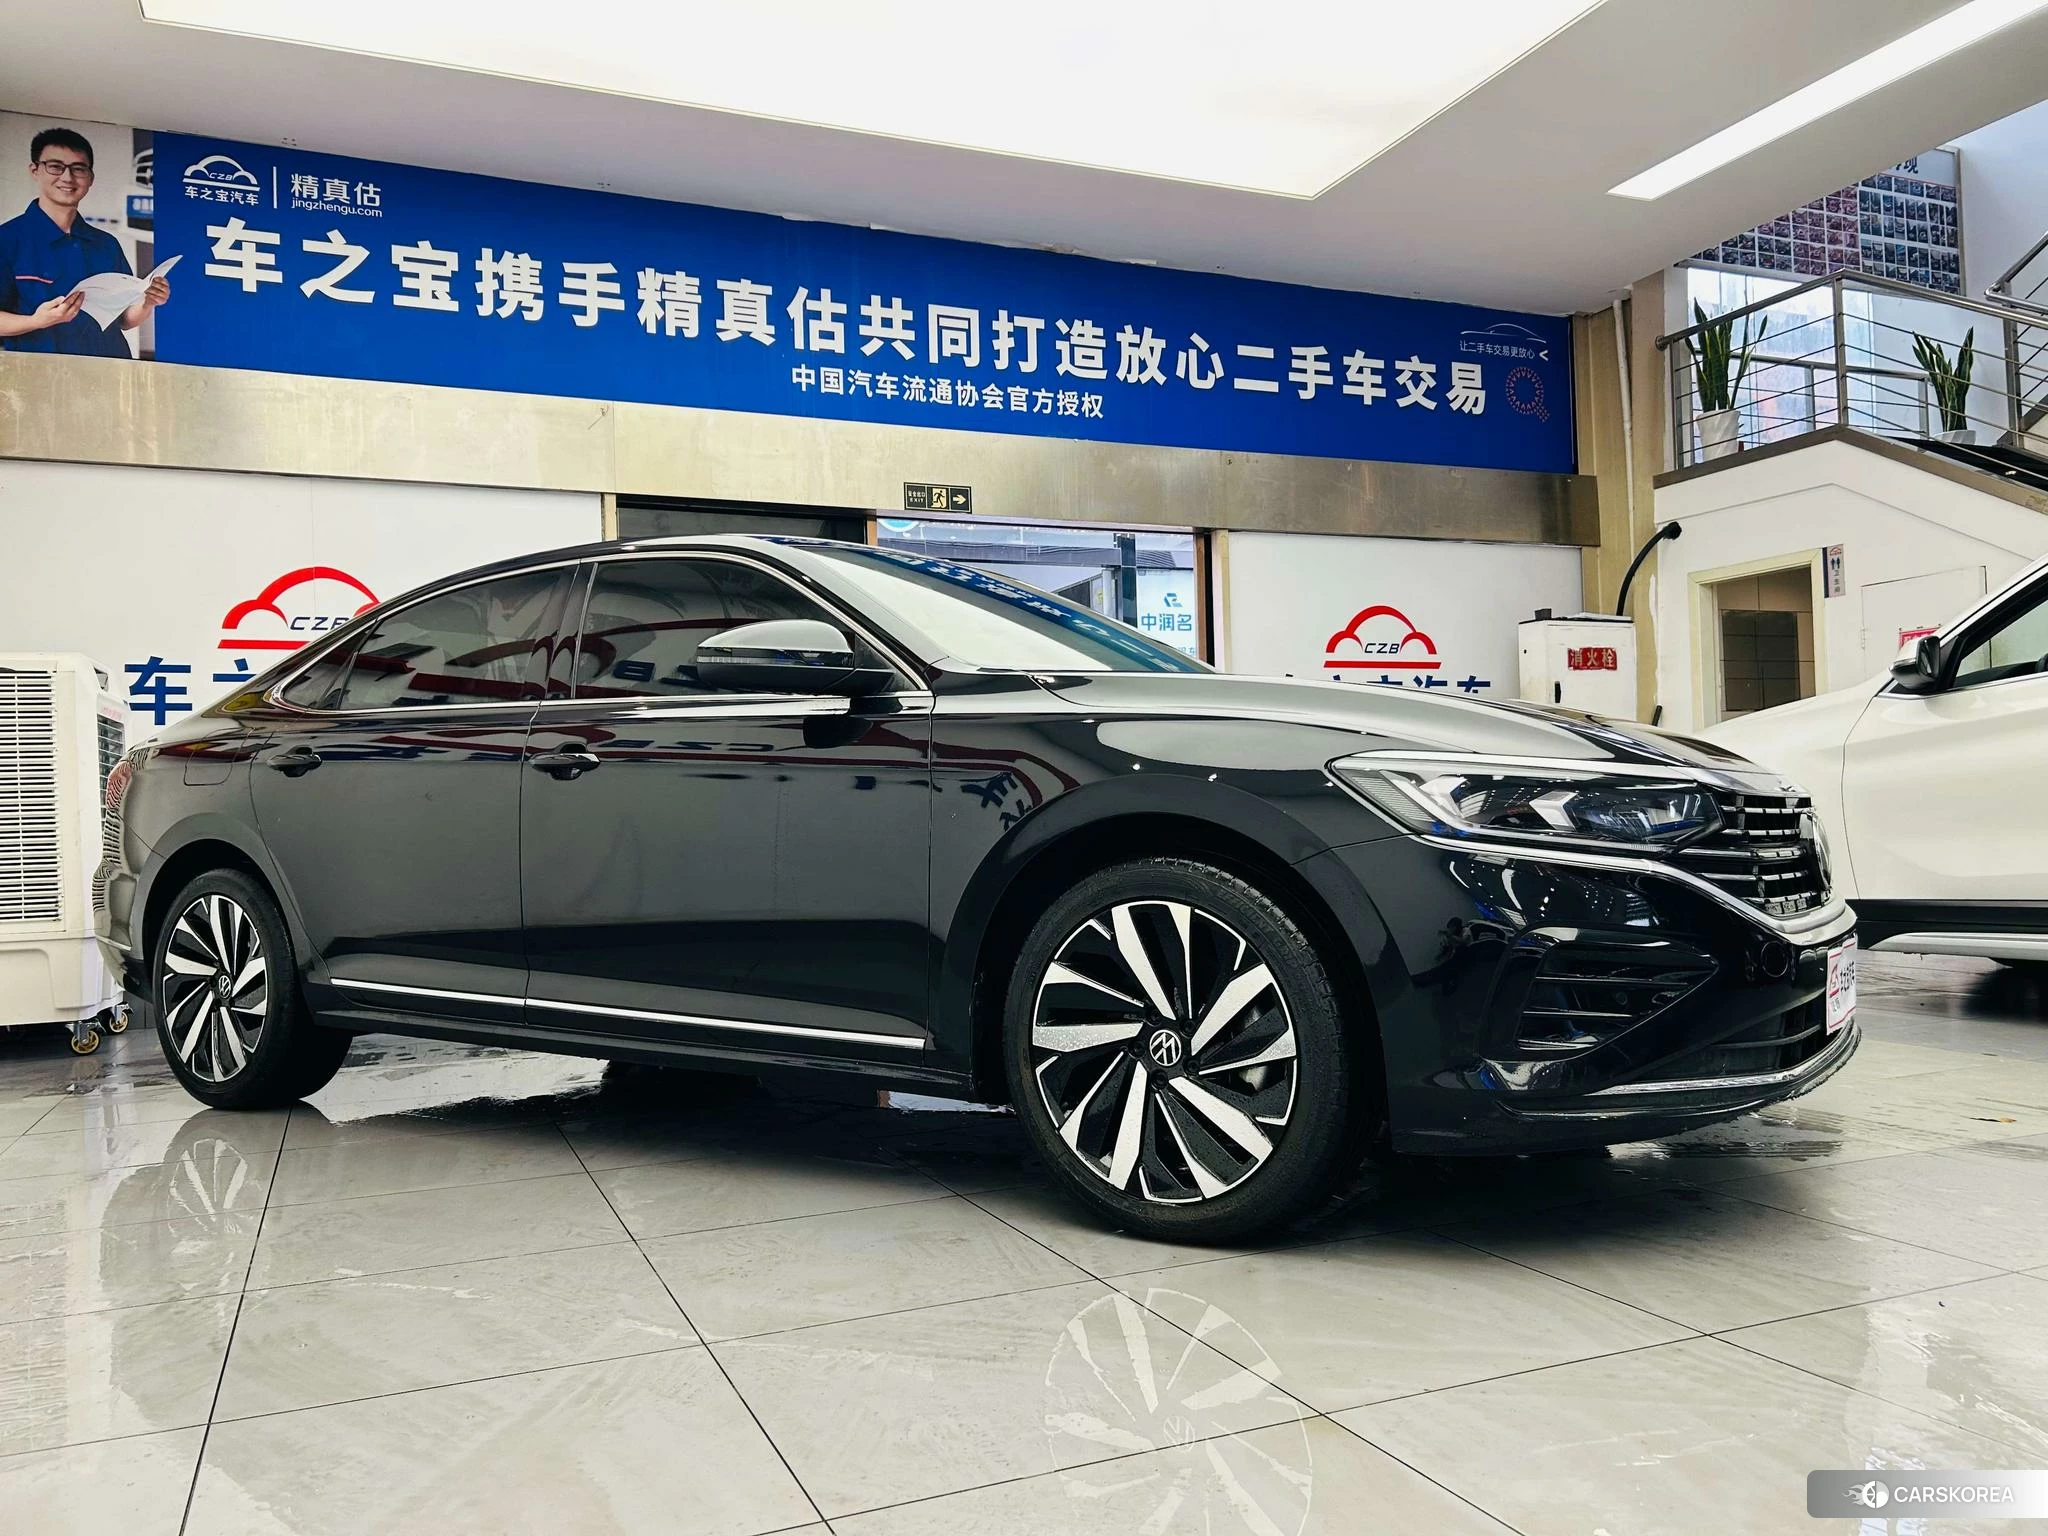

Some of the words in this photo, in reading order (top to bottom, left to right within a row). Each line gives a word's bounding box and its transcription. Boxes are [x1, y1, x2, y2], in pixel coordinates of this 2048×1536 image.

[209, 172, 233, 181] CZB
[184, 185, 260, 206] 车之宝汽车
[290, 173, 381, 207] 精真估
[290, 197, 383, 218] jingzhengu.com
[204, 217, 1487, 416] 车之宝携手精真估共同打造放心二手车交易
[1460, 340, 1536, 359] 让二手车交易更放心
[791, 363, 1104, 419] 中国汽车流通协会官方授权
[1364, 642, 1400, 654] CZB
[1570, 648, 1615, 667] 消火栓
